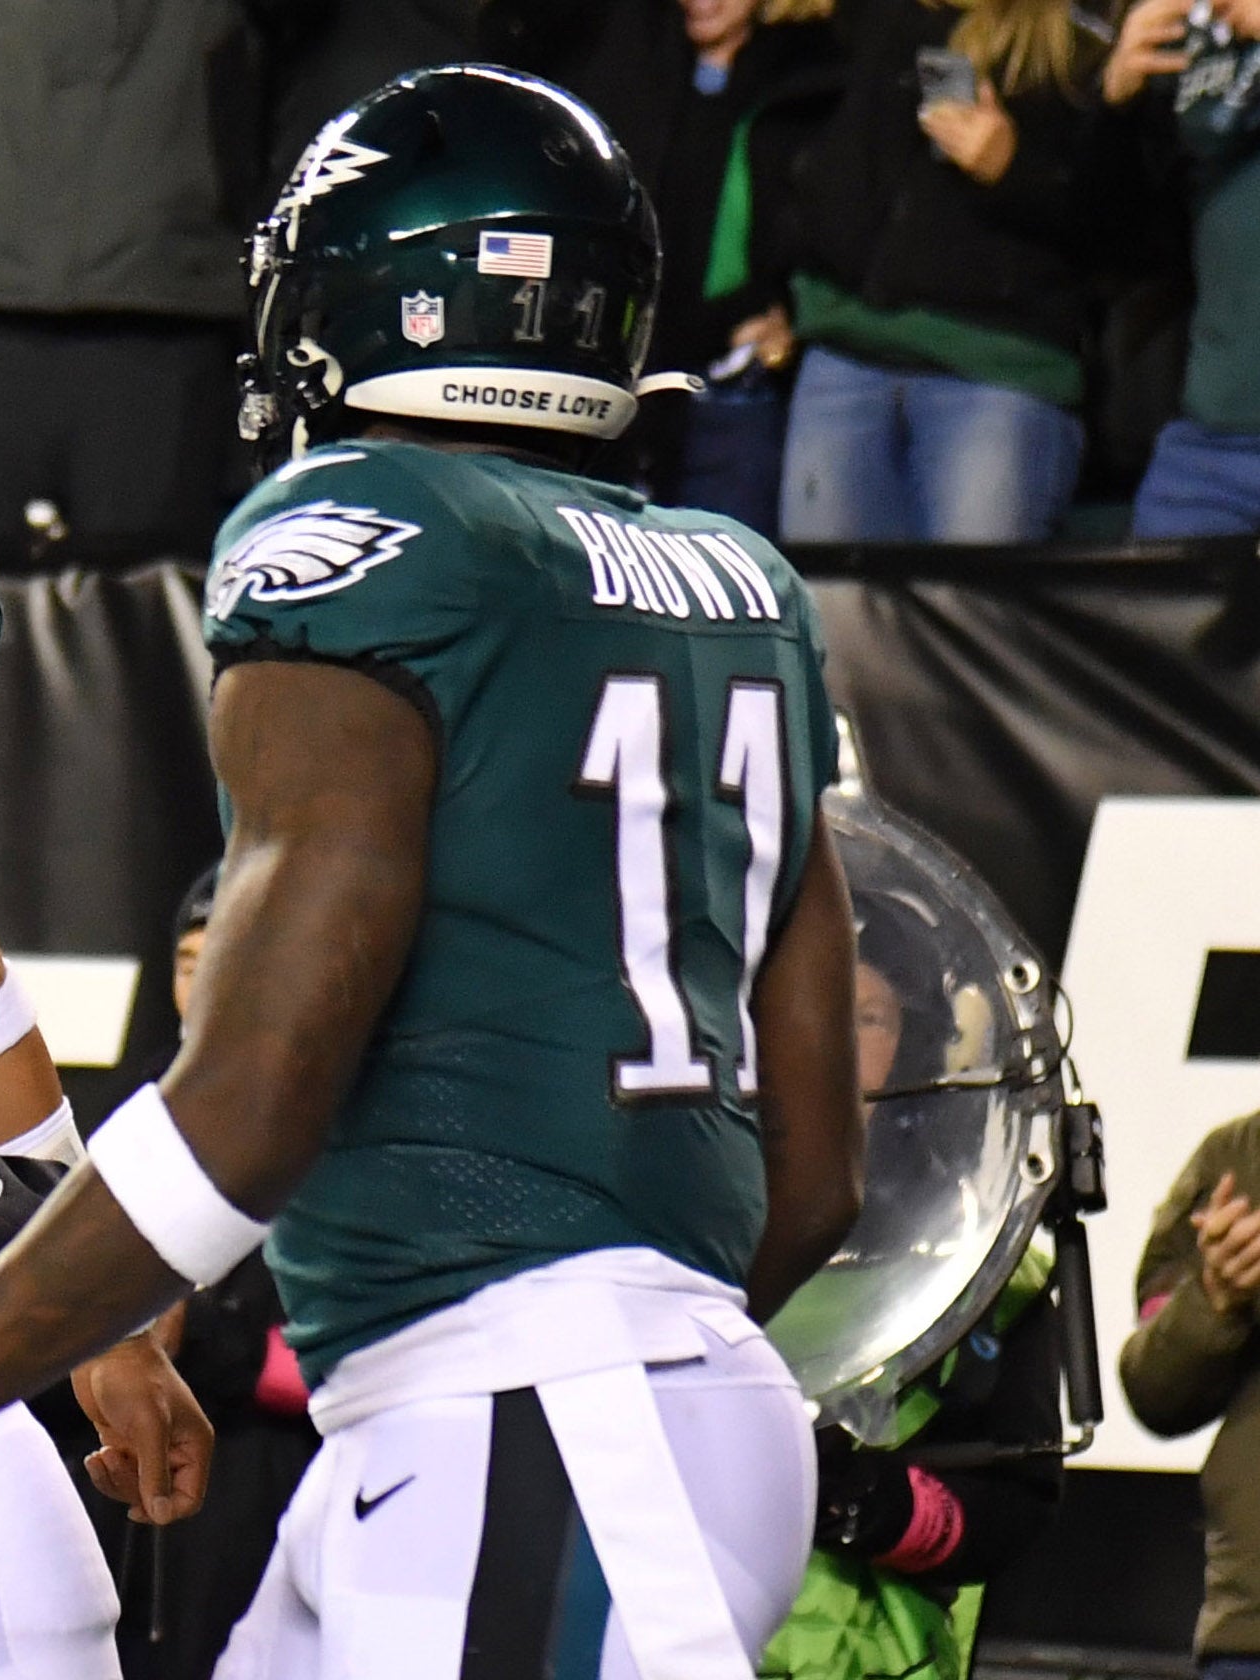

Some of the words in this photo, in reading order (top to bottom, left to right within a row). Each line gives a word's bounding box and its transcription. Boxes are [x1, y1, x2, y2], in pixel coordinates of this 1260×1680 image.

[443, 383, 552, 411] CHOOSE
[556, 394, 612, 420] LOVE
[555, 506, 781, 620] BROWN
[575, 673, 786, 1104] 11
